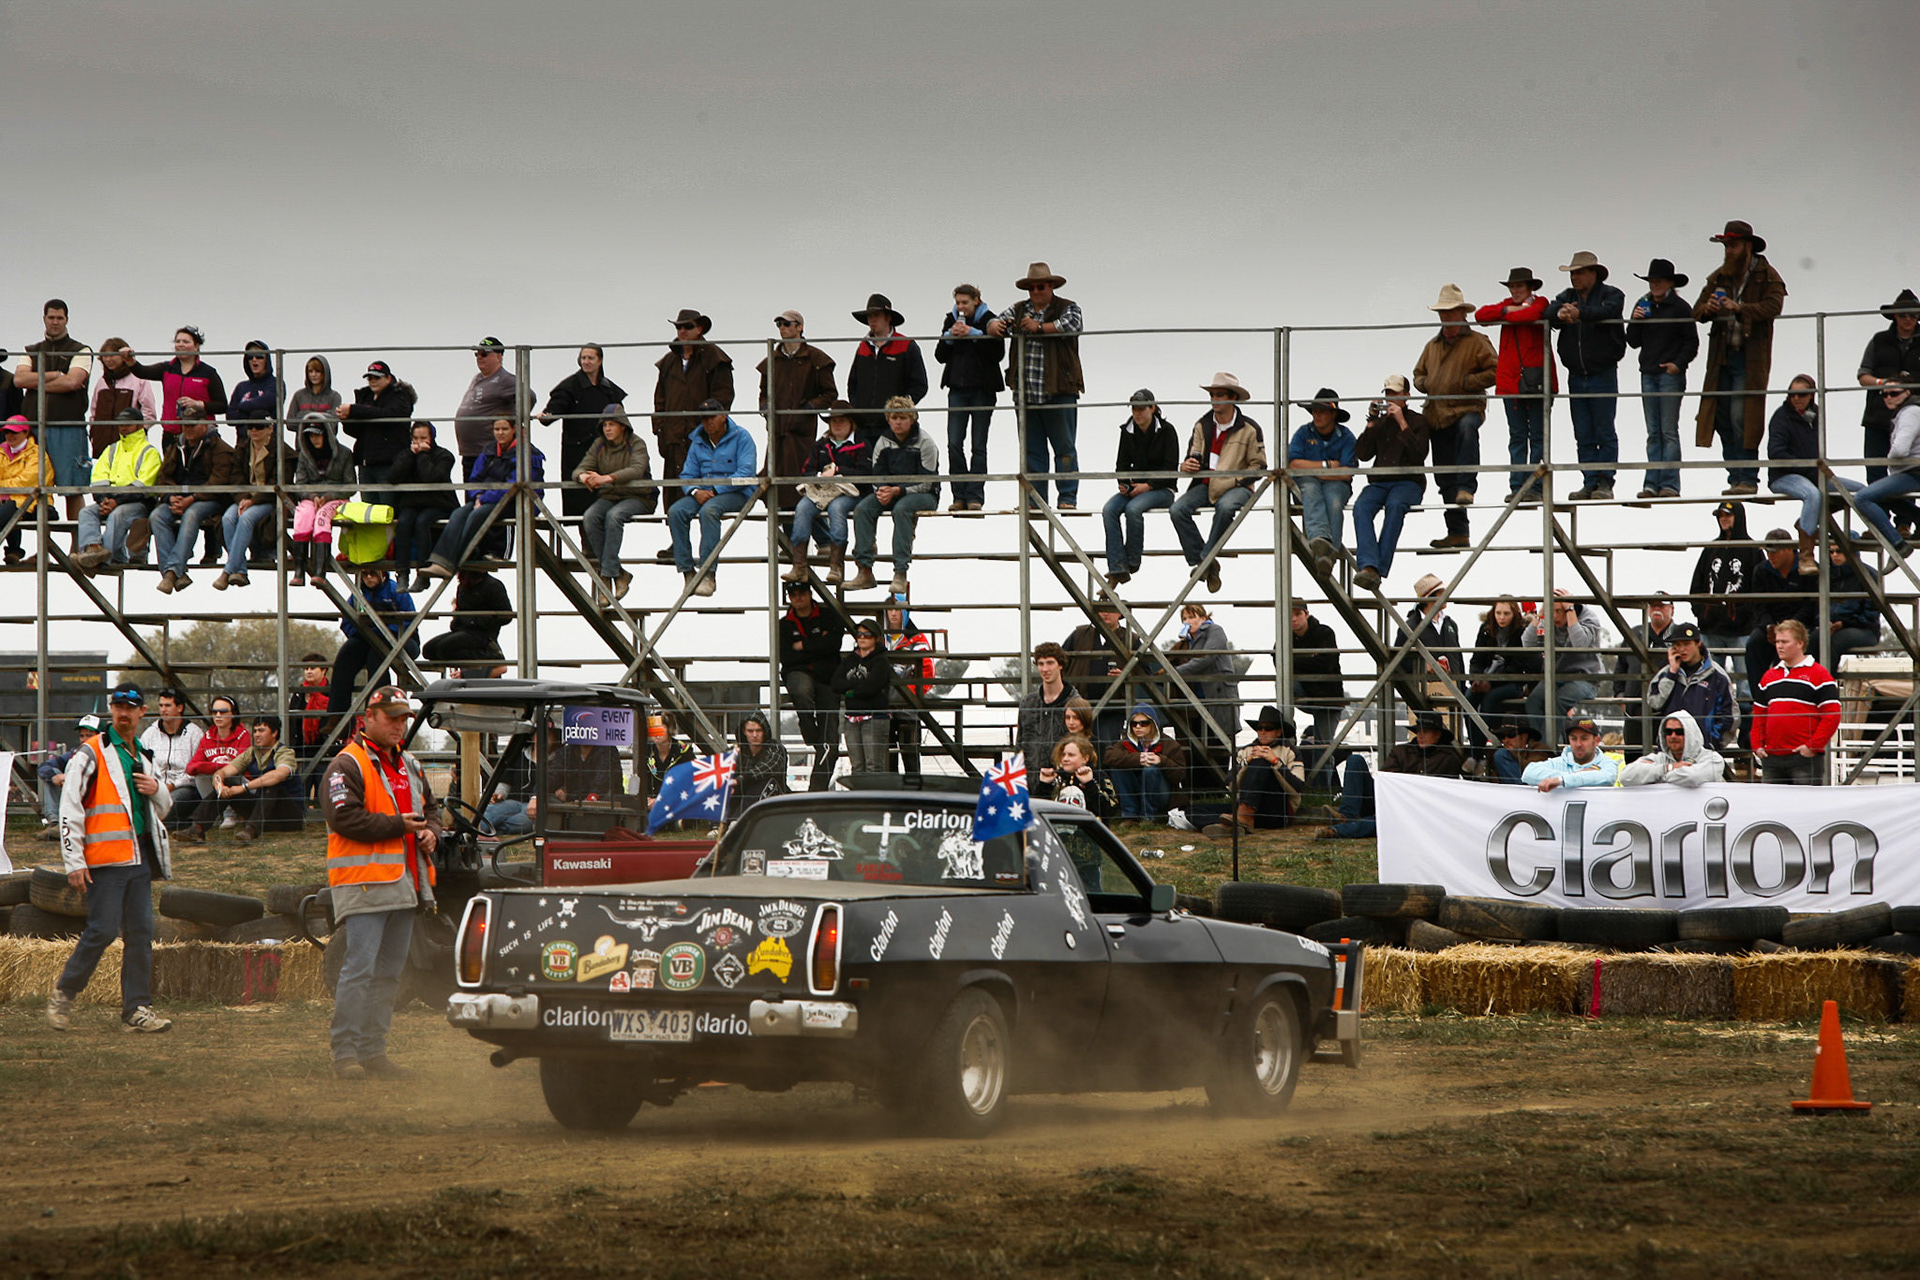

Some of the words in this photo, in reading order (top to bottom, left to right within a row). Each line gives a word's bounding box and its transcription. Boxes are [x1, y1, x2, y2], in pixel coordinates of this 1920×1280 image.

[601, 710, 631, 724] EVENT
[605, 728, 626, 741] HIRE
[553, 857, 612, 870] Kawasaki
[758, 902, 779, 917] JACK
[696, 912, 721, 934] JIM
[721, 908, 753, 936] BEAM
[499, 938, 520, 958] SUCH
[523, 930, 532, 941] IS
[537, 916, 554, 932] LIFE
[544, 943, 577, 957] VICTORIA
[666, 944, 700, 958] VICTORIA
[553, 955, 566, 965] VB
[582, 955, 621, 975] Bundaberg
[671, 960, 692, 973] VB
[544, 967, 574, 979] BITTER
[667, 977, 697, 988] BITTER
[612, 1012, 645, 1034] WXS
[658, 1012, 690, 1034] 403
[695, 1012, 752, 1035] clario
